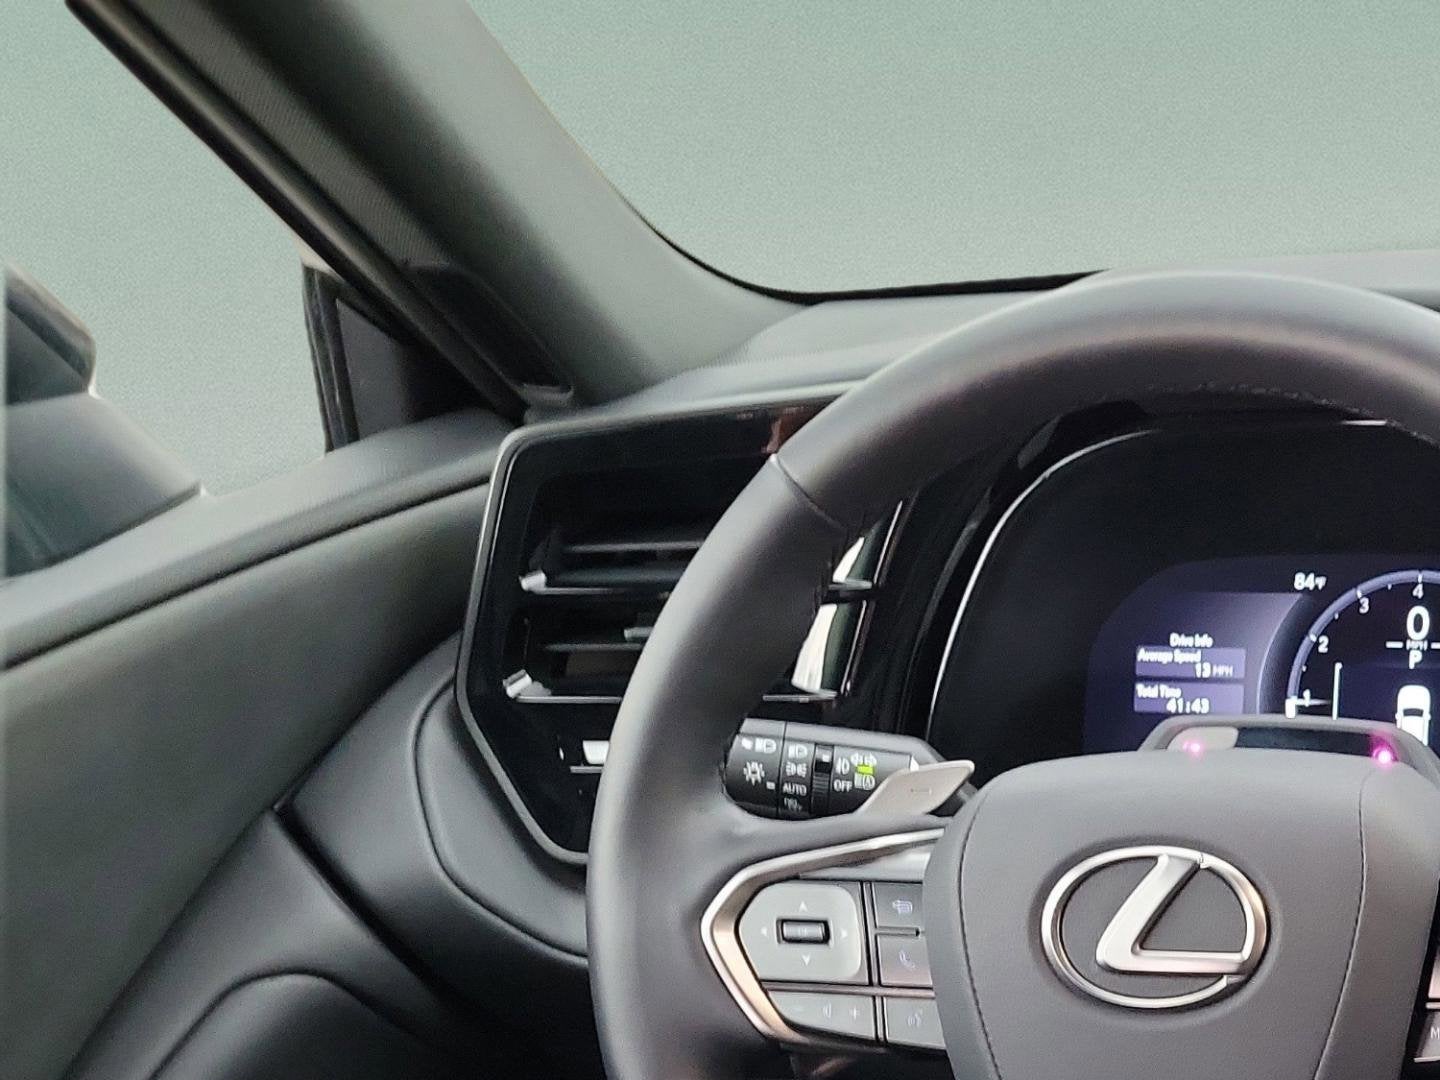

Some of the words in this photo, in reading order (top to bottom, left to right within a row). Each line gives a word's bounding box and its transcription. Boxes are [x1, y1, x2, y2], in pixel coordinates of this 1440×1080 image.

[1412, 583, 1424, 599] 4
[1359, 597, 1370, 614] 3
[1406, 605, 1430, 641] 0
[1169, 632, 1194, 648] Drive
[1194, 633, 1214, 648] Info
[1318, 635, 1329, 653] 2
[1136, 647, 1173, 664] Average
[1173, 648, 1202, 665] Speed
[1408, 650, 1423, 670] P
[1136, 683, 1158, 698] Total
[1159, 684, 1181, 699] Time
[1166, 697, 1210, 714] 41:43
[782, 782, 807, 796] AUTO
[833, 779, 852, 792] OFF
